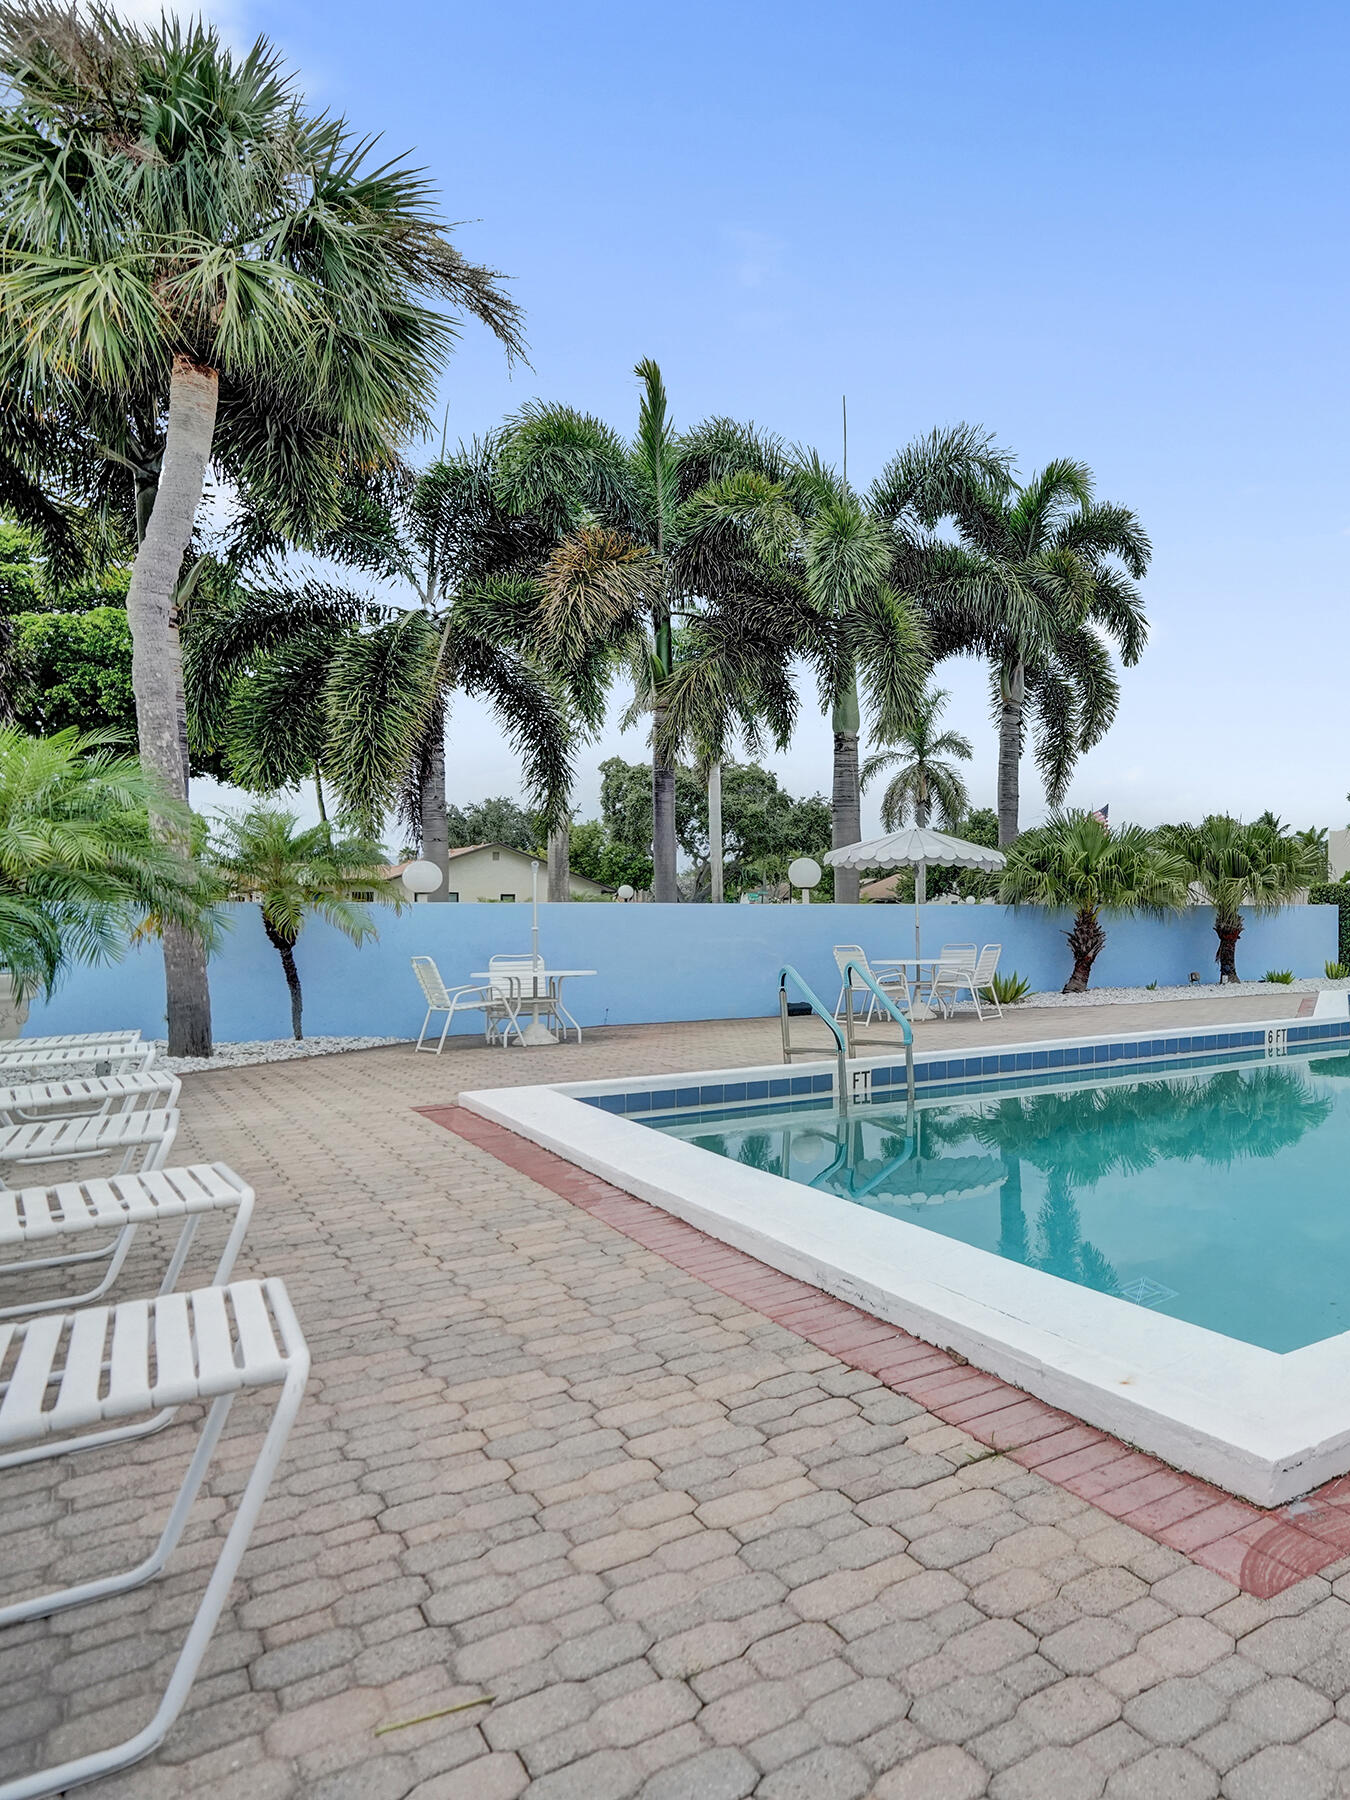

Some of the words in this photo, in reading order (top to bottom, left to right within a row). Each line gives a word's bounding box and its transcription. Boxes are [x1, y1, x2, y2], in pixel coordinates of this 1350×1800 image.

[1268, 1030, 1273, 1044] 6
[1276, 1029, 1286, 1043] FT
[853, 1071, 870, 1089] FT
